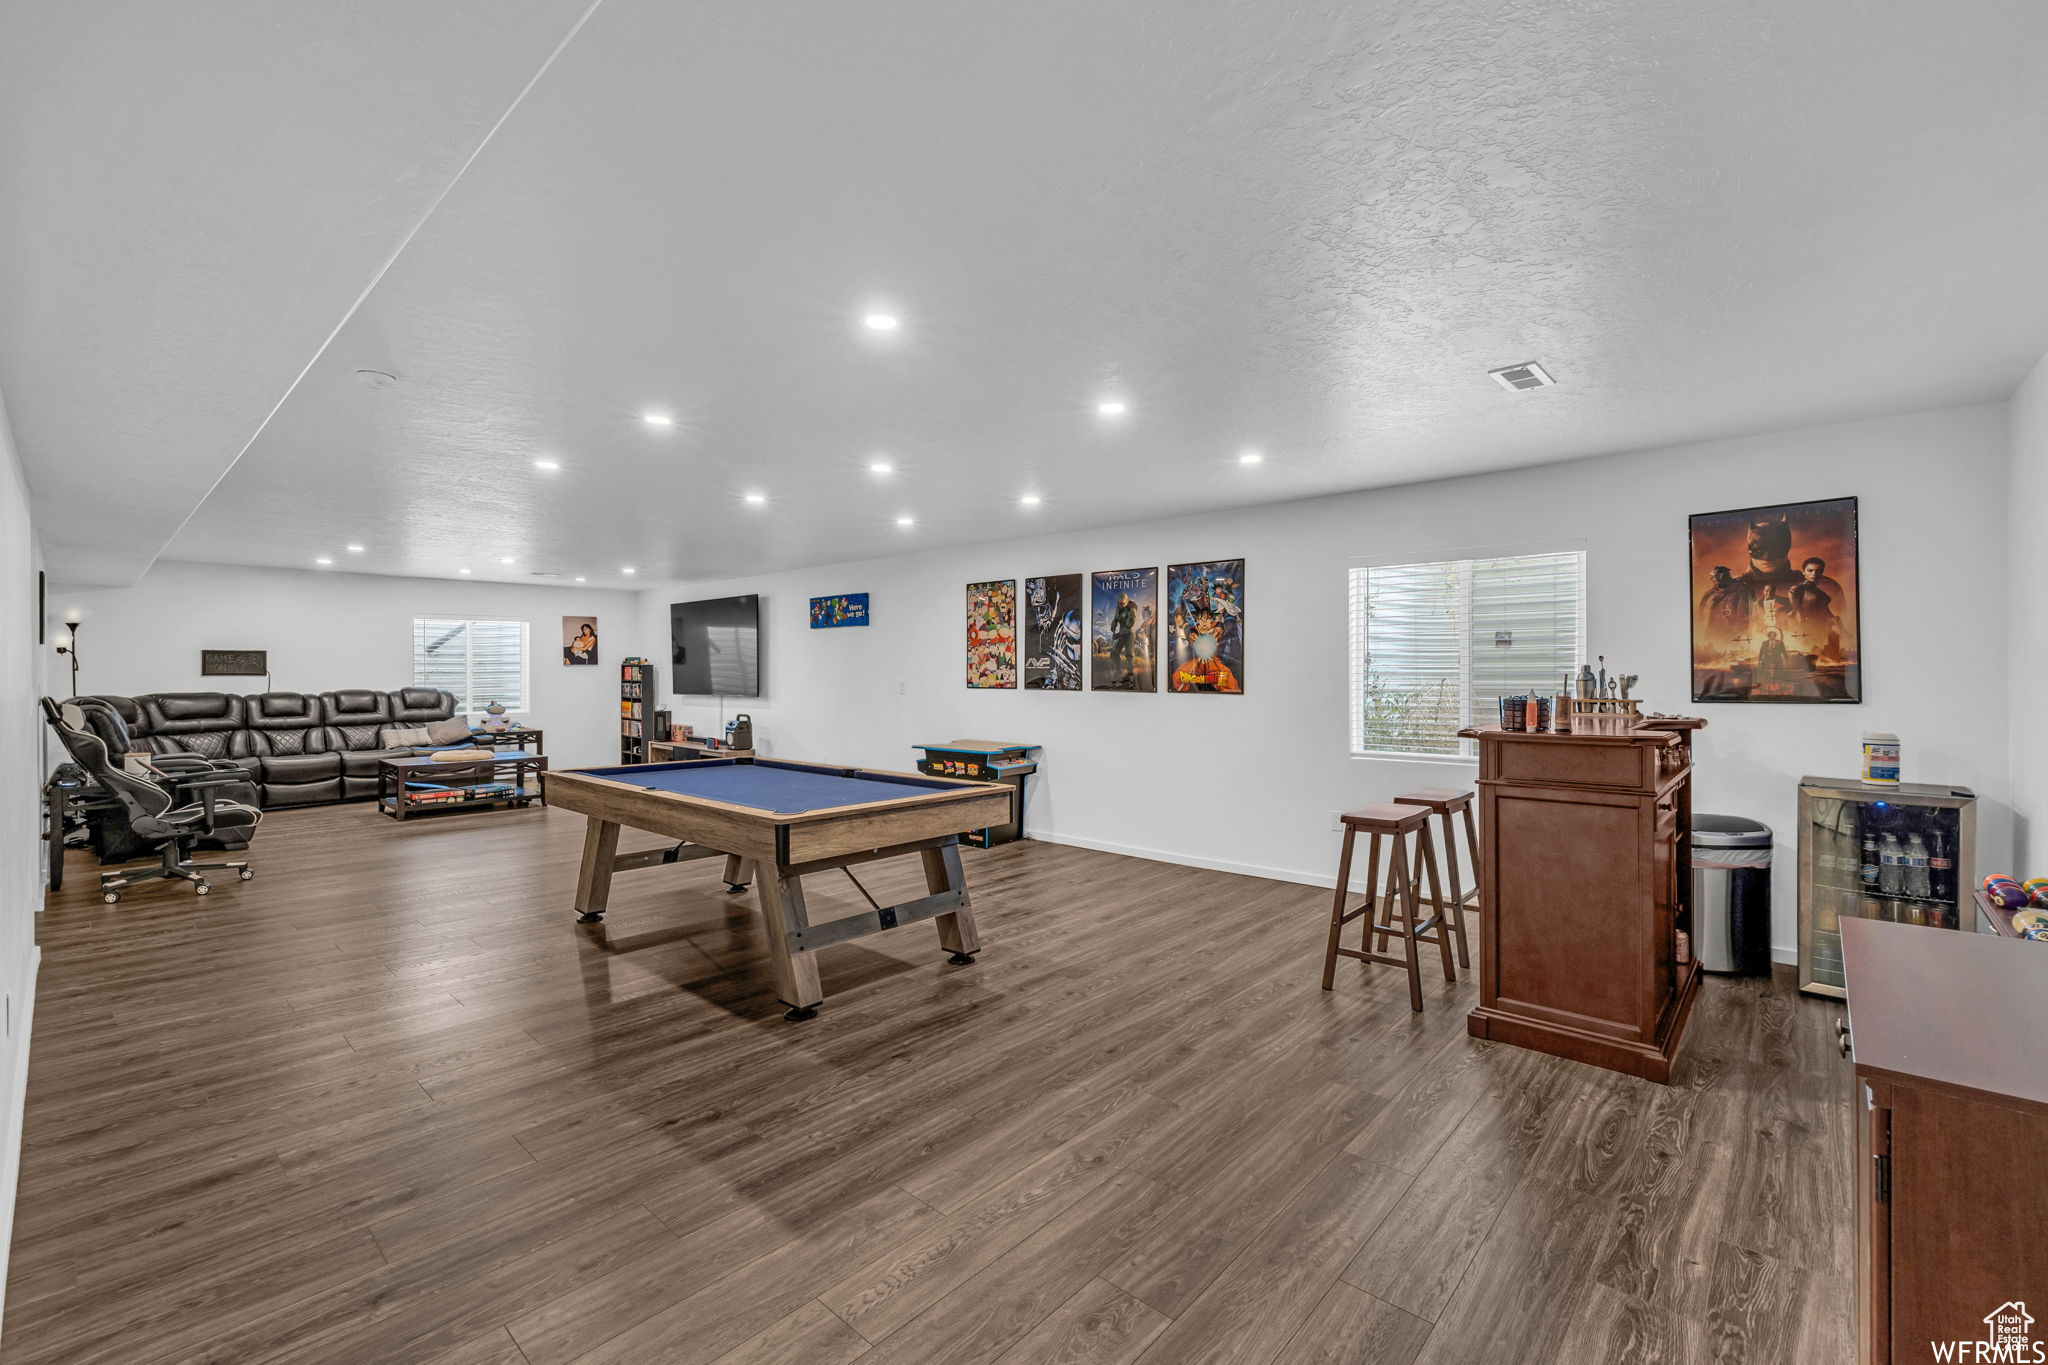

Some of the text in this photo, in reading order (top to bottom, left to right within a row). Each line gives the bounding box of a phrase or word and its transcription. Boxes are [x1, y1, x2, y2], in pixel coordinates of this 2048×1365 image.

[1109, 572, 1141, 581] HALO
[1102, 579, 1148, 591] INFINITE
[855, 610, 865, 618] go!
[207, 654, 236, 663] GAME
[1025, 657, 1050, 667] AVP
[1179, 670, 1205, 684] DRAGON
